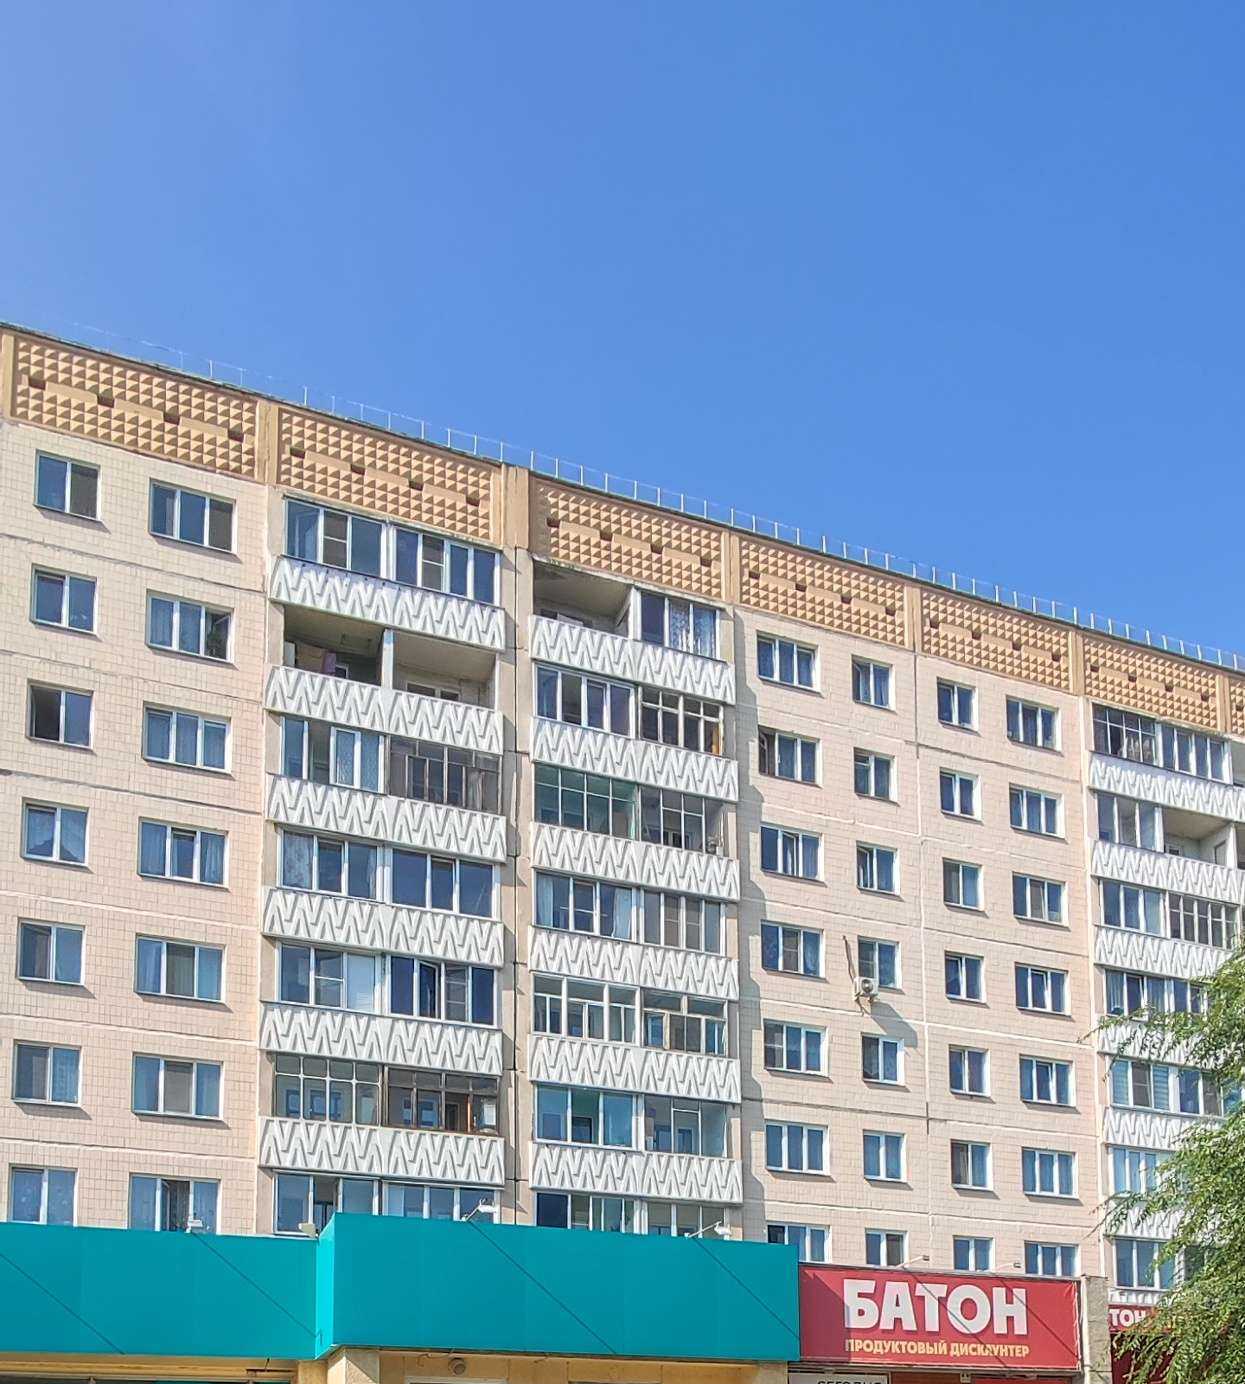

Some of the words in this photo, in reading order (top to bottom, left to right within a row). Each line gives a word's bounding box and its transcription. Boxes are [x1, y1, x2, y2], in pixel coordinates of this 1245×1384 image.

[843, 1278, 1028, 1336] БАТОН
[1108, 1308, 1147, 1328] ТОН
[846, 1338, 948, 1356] ПРОДУКТОВЫЙ
[949, 1342, 1030, 1358] ДИСКАУНТЕР
